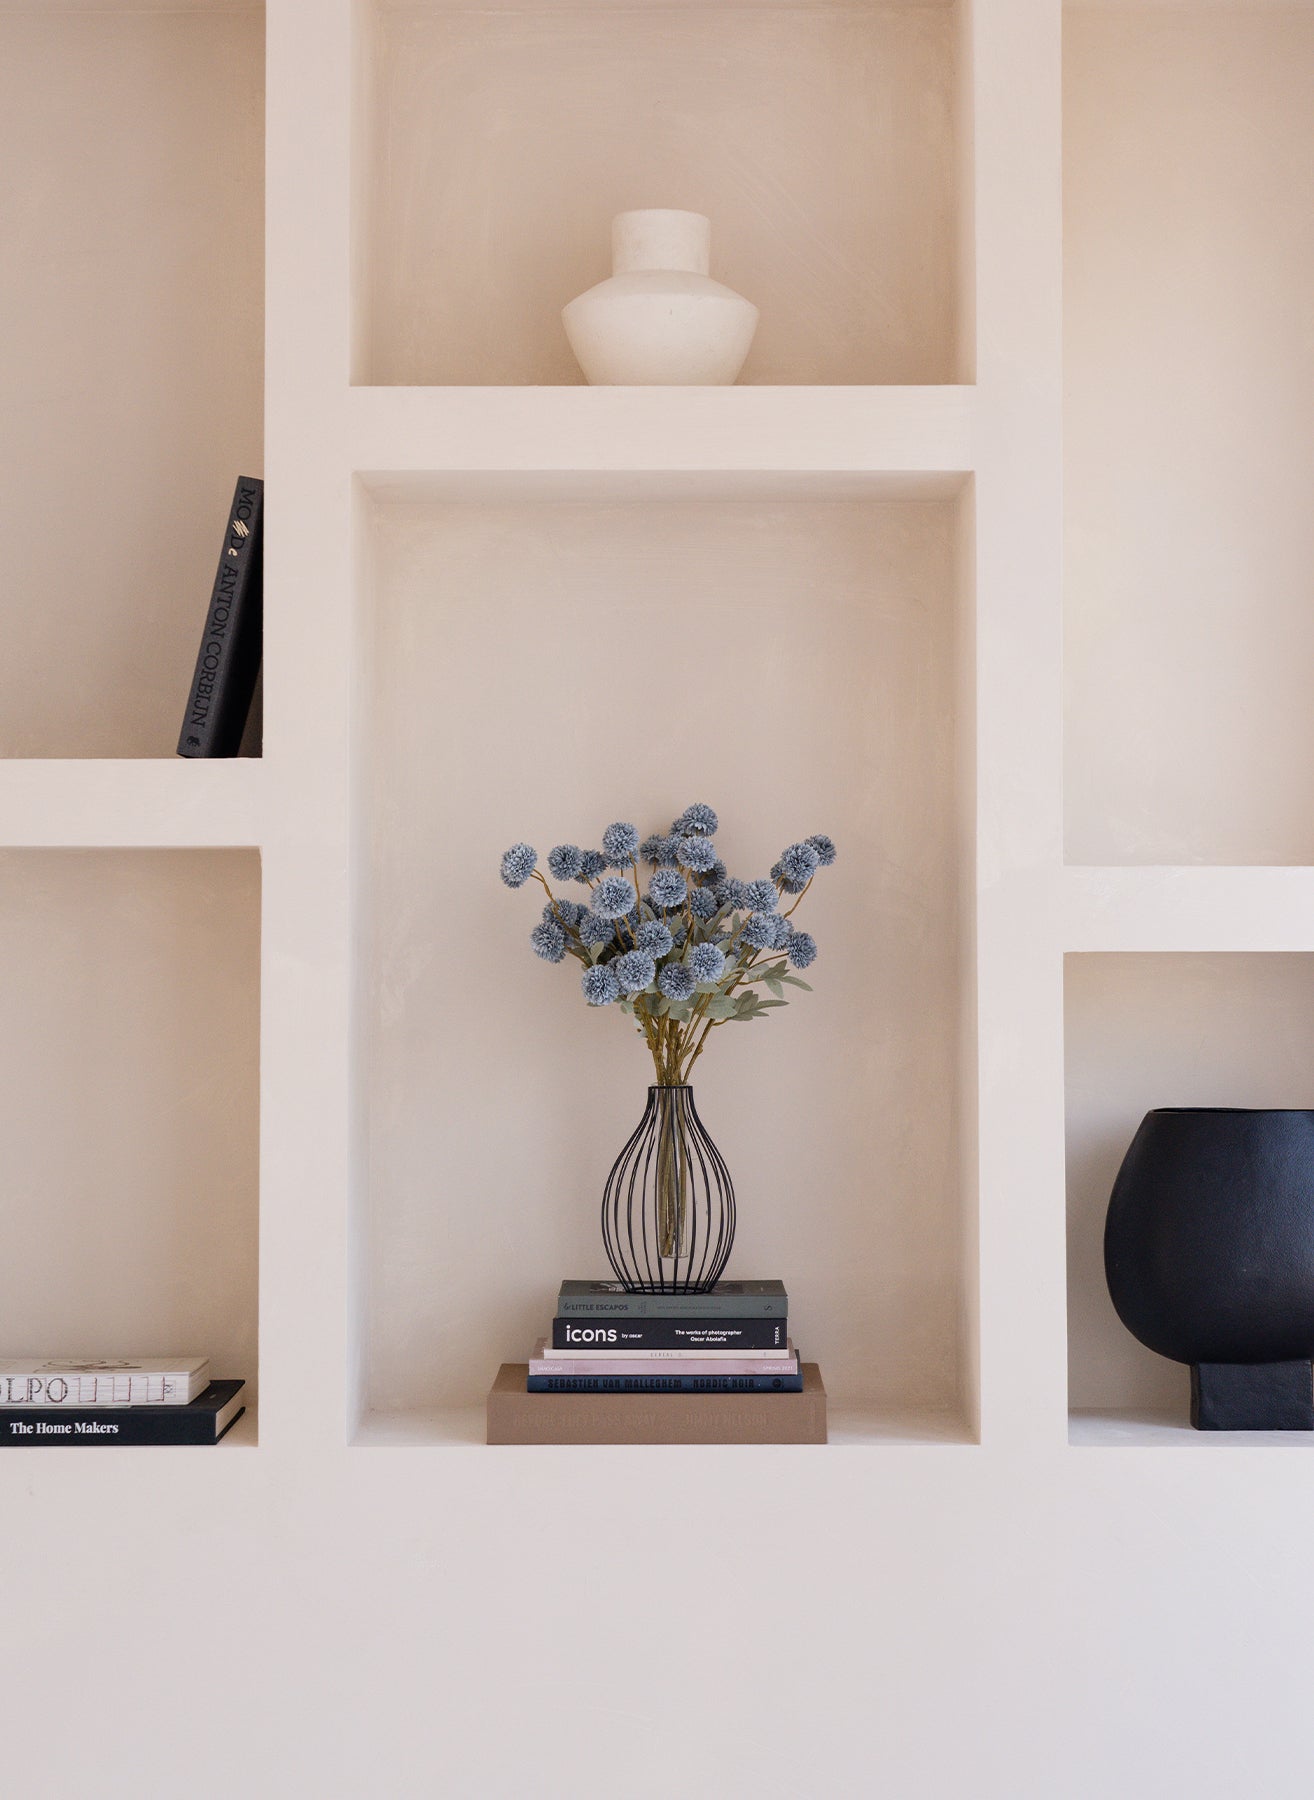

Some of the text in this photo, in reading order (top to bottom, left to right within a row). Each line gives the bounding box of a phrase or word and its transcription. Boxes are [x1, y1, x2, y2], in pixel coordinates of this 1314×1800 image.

[210, 563, 239, 639] ANTON
[190, 641, 222, 729] CORBIJN
[566, 1324, 618, 1342] icons
[708, 1329, 742, 1337] photographer
[547, 1378, 599, 1389] SEBASTIEN
[602, 1378, 620, 1389] VAN
[693, 1378, 754, 1389] NORDIC NOIR
[10, 1422, 119, 1434] The Home Makers
